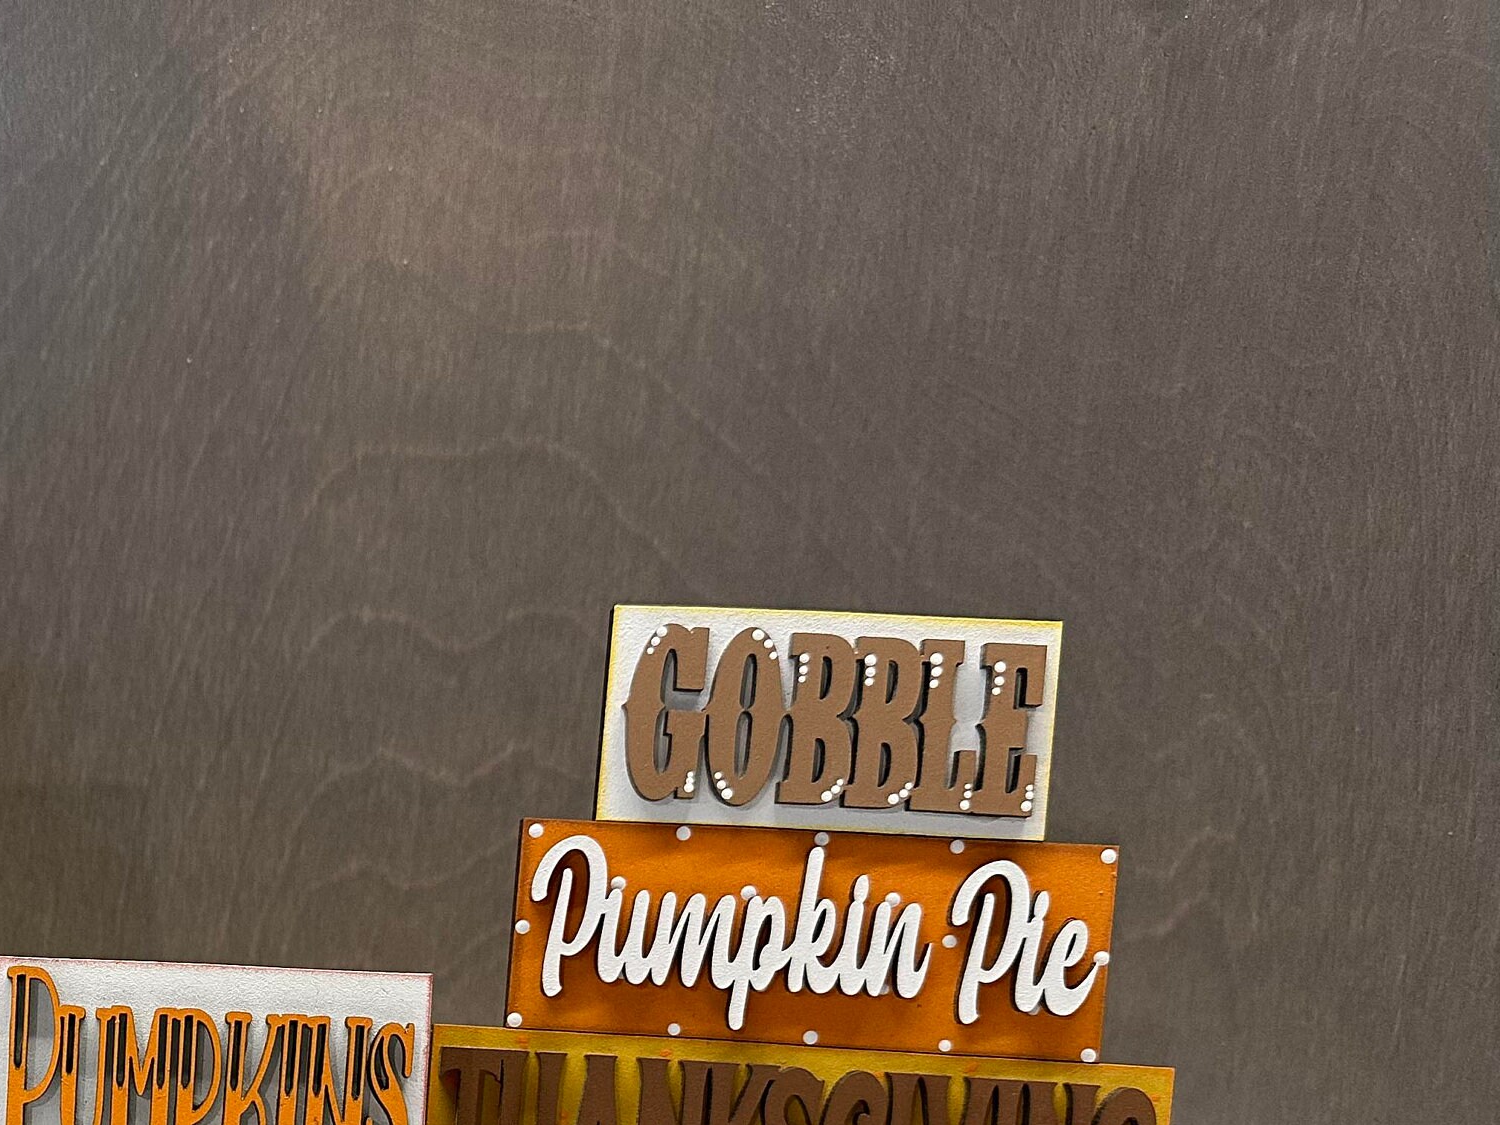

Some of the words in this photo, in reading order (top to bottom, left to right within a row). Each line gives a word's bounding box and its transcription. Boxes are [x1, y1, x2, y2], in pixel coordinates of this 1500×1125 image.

[622, 624, 1046, 817] GOBBLE
[531, 835, 932, 1030] Pumpkin
[952, 859, 1096, 1025] Pie
